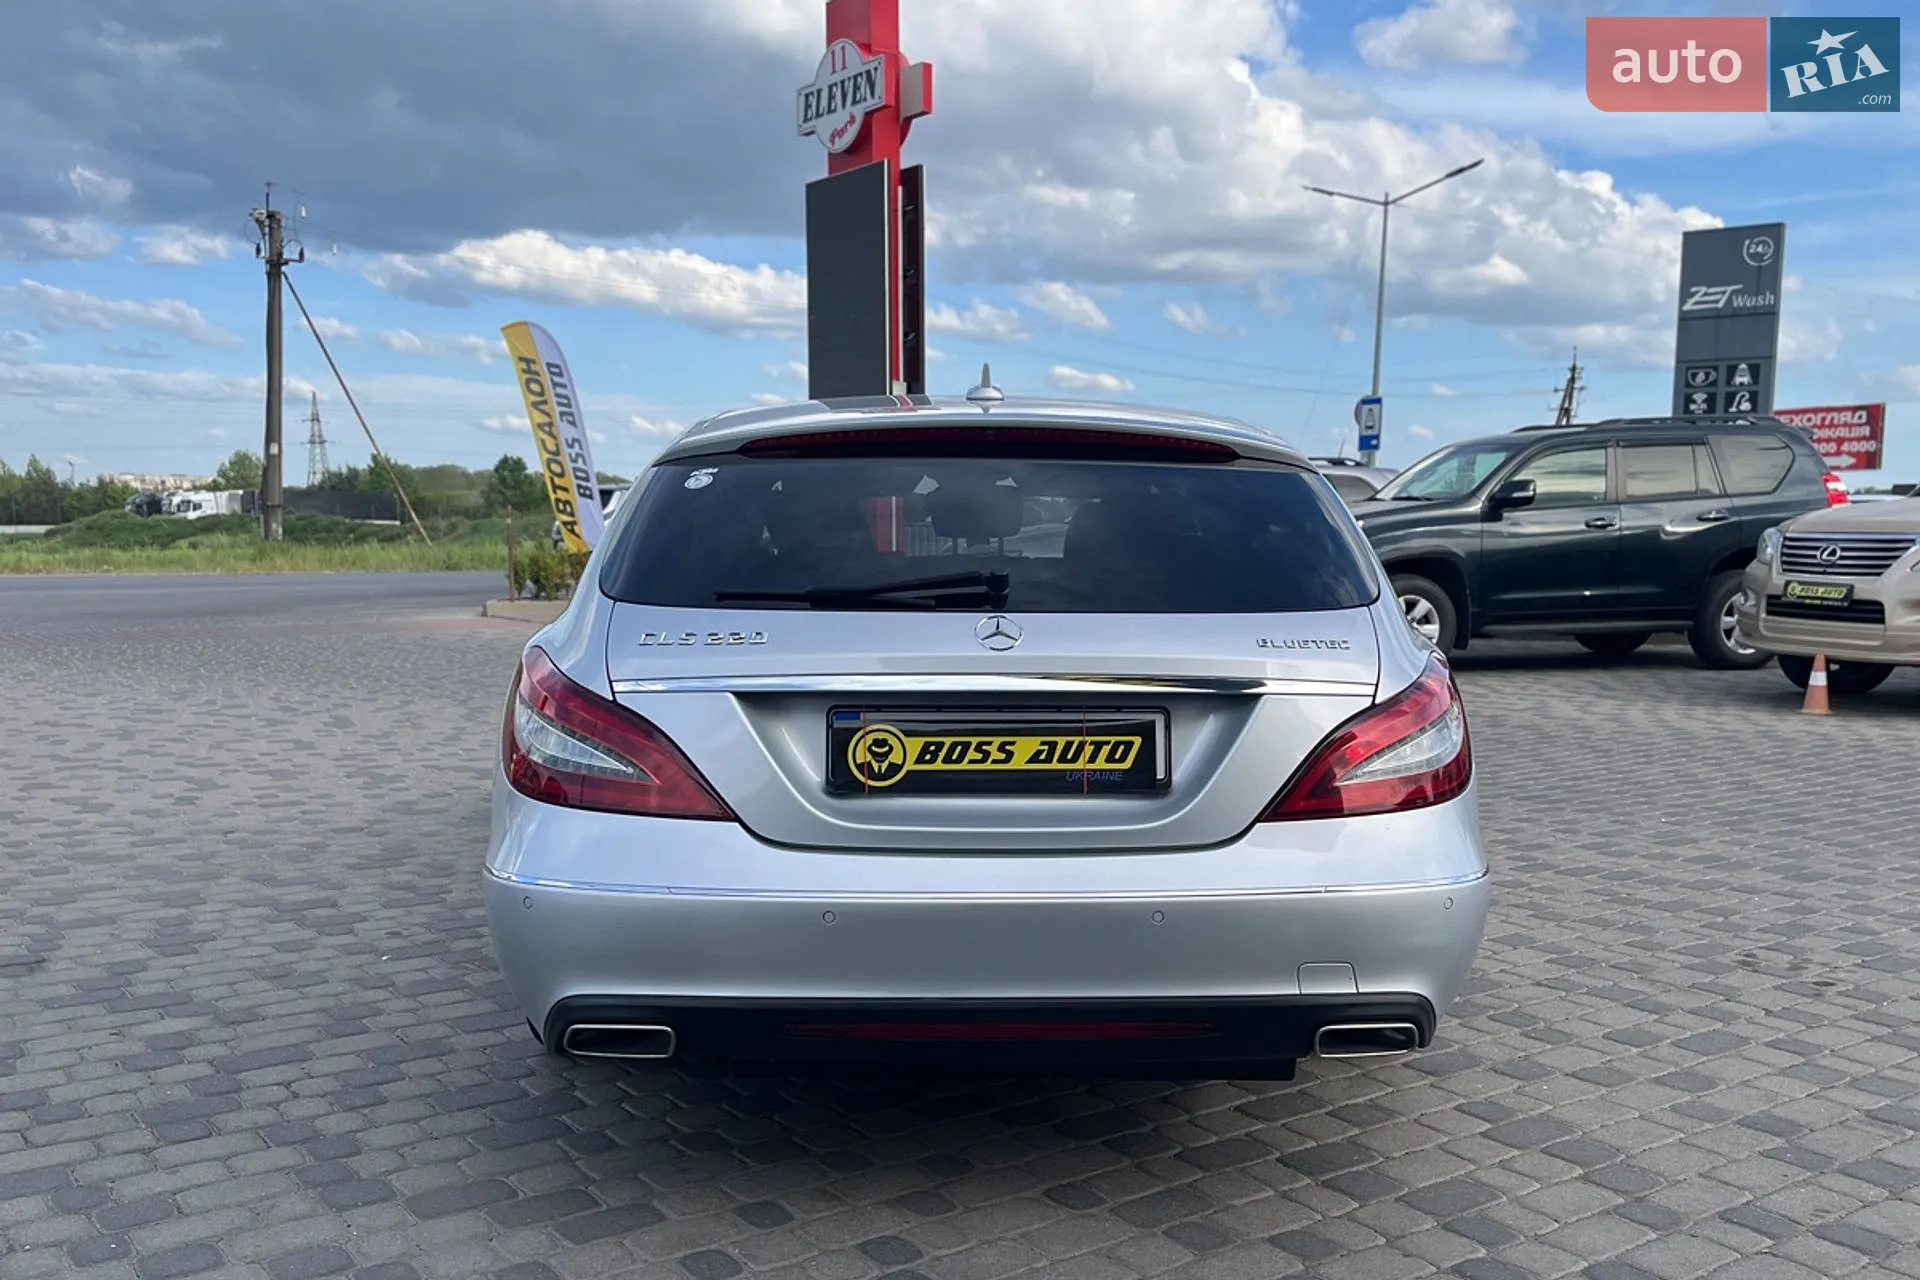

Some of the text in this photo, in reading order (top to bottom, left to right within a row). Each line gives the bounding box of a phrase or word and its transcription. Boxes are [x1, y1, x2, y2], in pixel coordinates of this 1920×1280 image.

[830, 45, 848, 75] 11
[802, 66, 879, 124] ELEVEN
[1732, 291, 1775, 308] Wash
[517, 355, 581, 540] АВТОСАЛОН
[1839, 440, 1877, 452] 4000
[565, 437, 595, 501] BOSS
[638, 631, 769, 646] CLS 220
[1256, 638, 1351, 650] BLUETEC
[913, 740, 1136, 765] BOSS AUTO
[1065, 770, 1123, 781] UKRAINE
